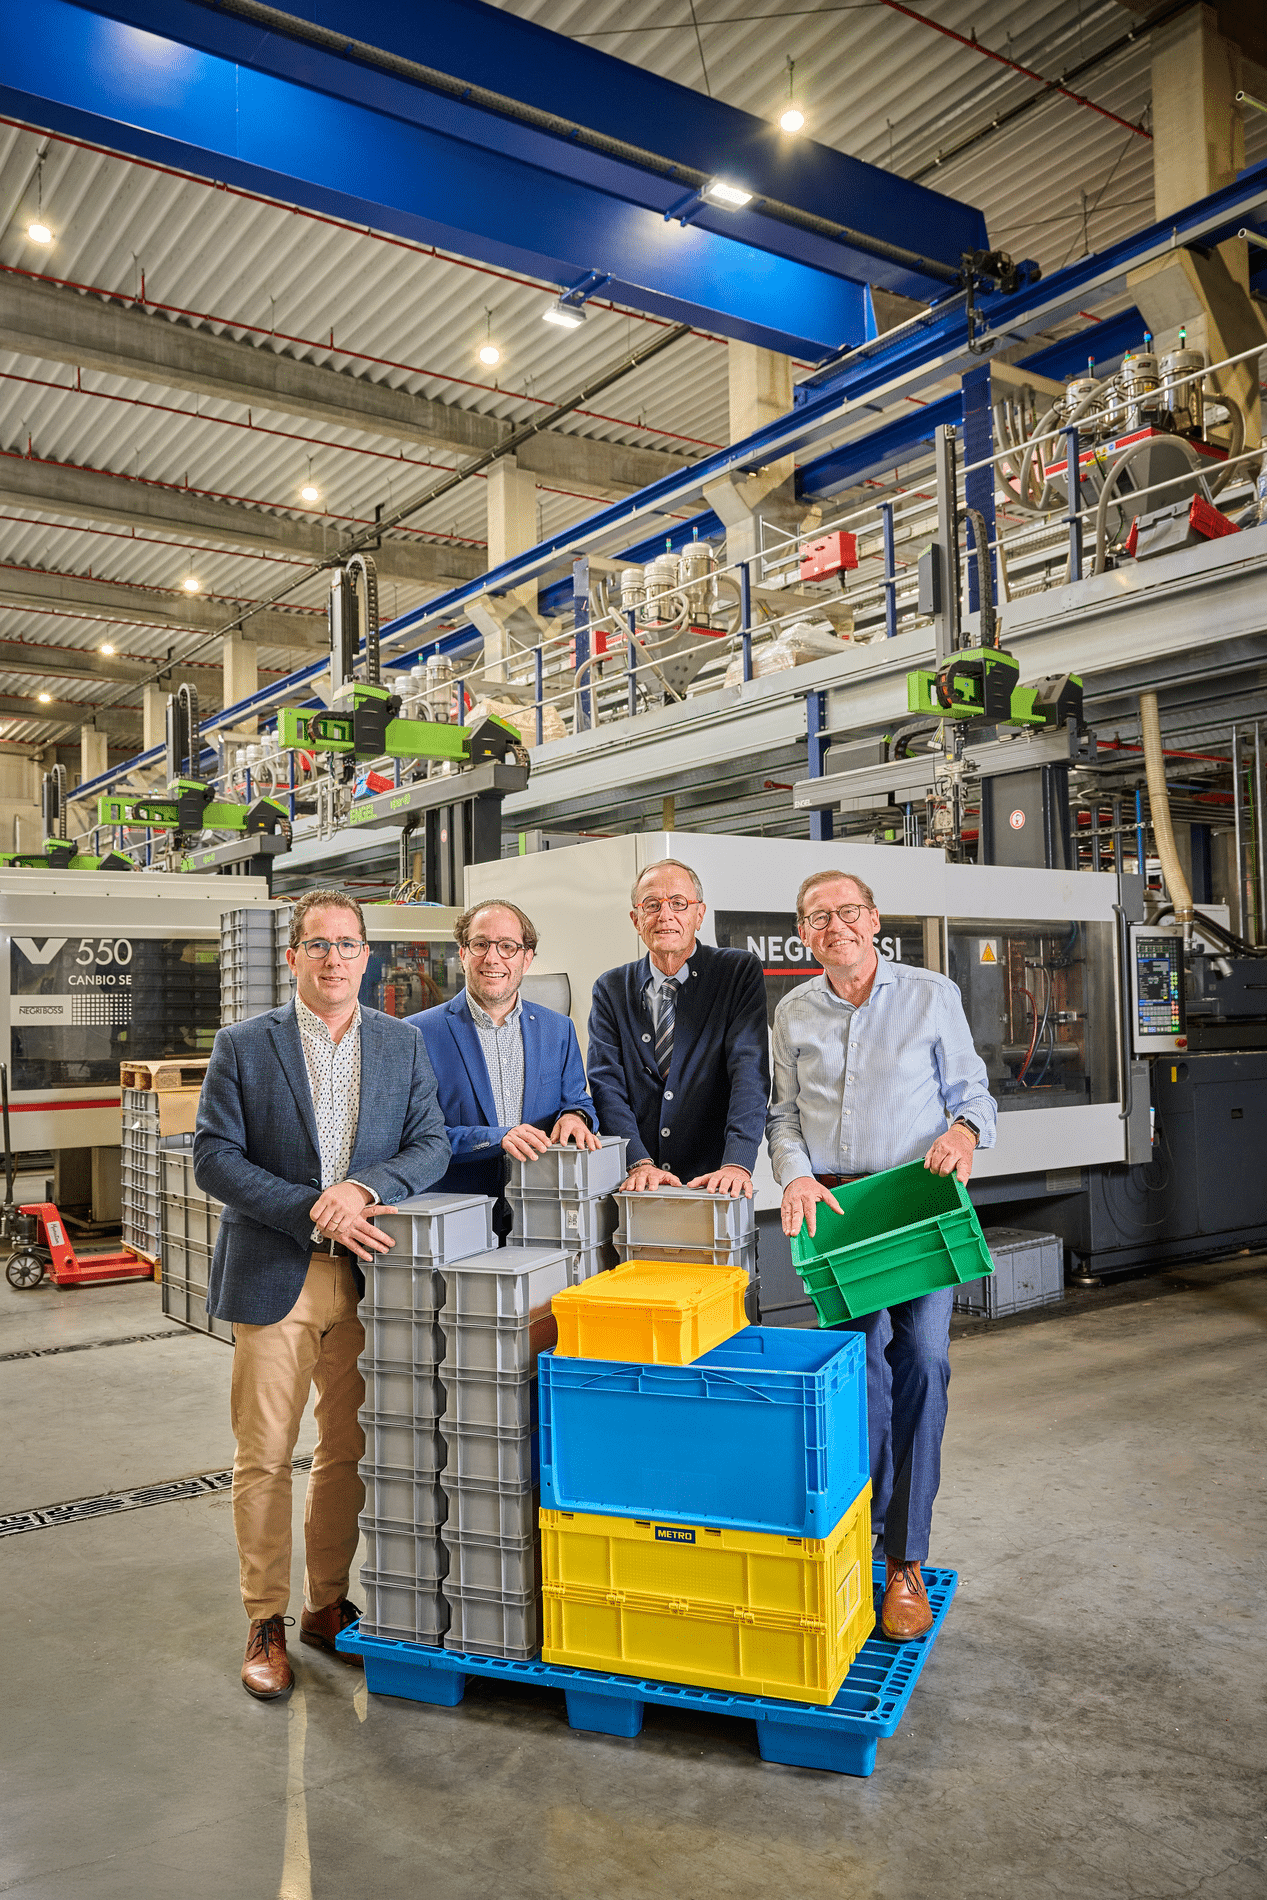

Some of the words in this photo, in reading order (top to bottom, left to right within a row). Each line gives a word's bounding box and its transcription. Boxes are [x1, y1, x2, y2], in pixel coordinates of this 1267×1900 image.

[76, 939, 132, 965] 550
[68, 975, 116, 985] CANBIO
[119, 975, 132, 985] SE
[657, 1530, 692, 1540] METRO
